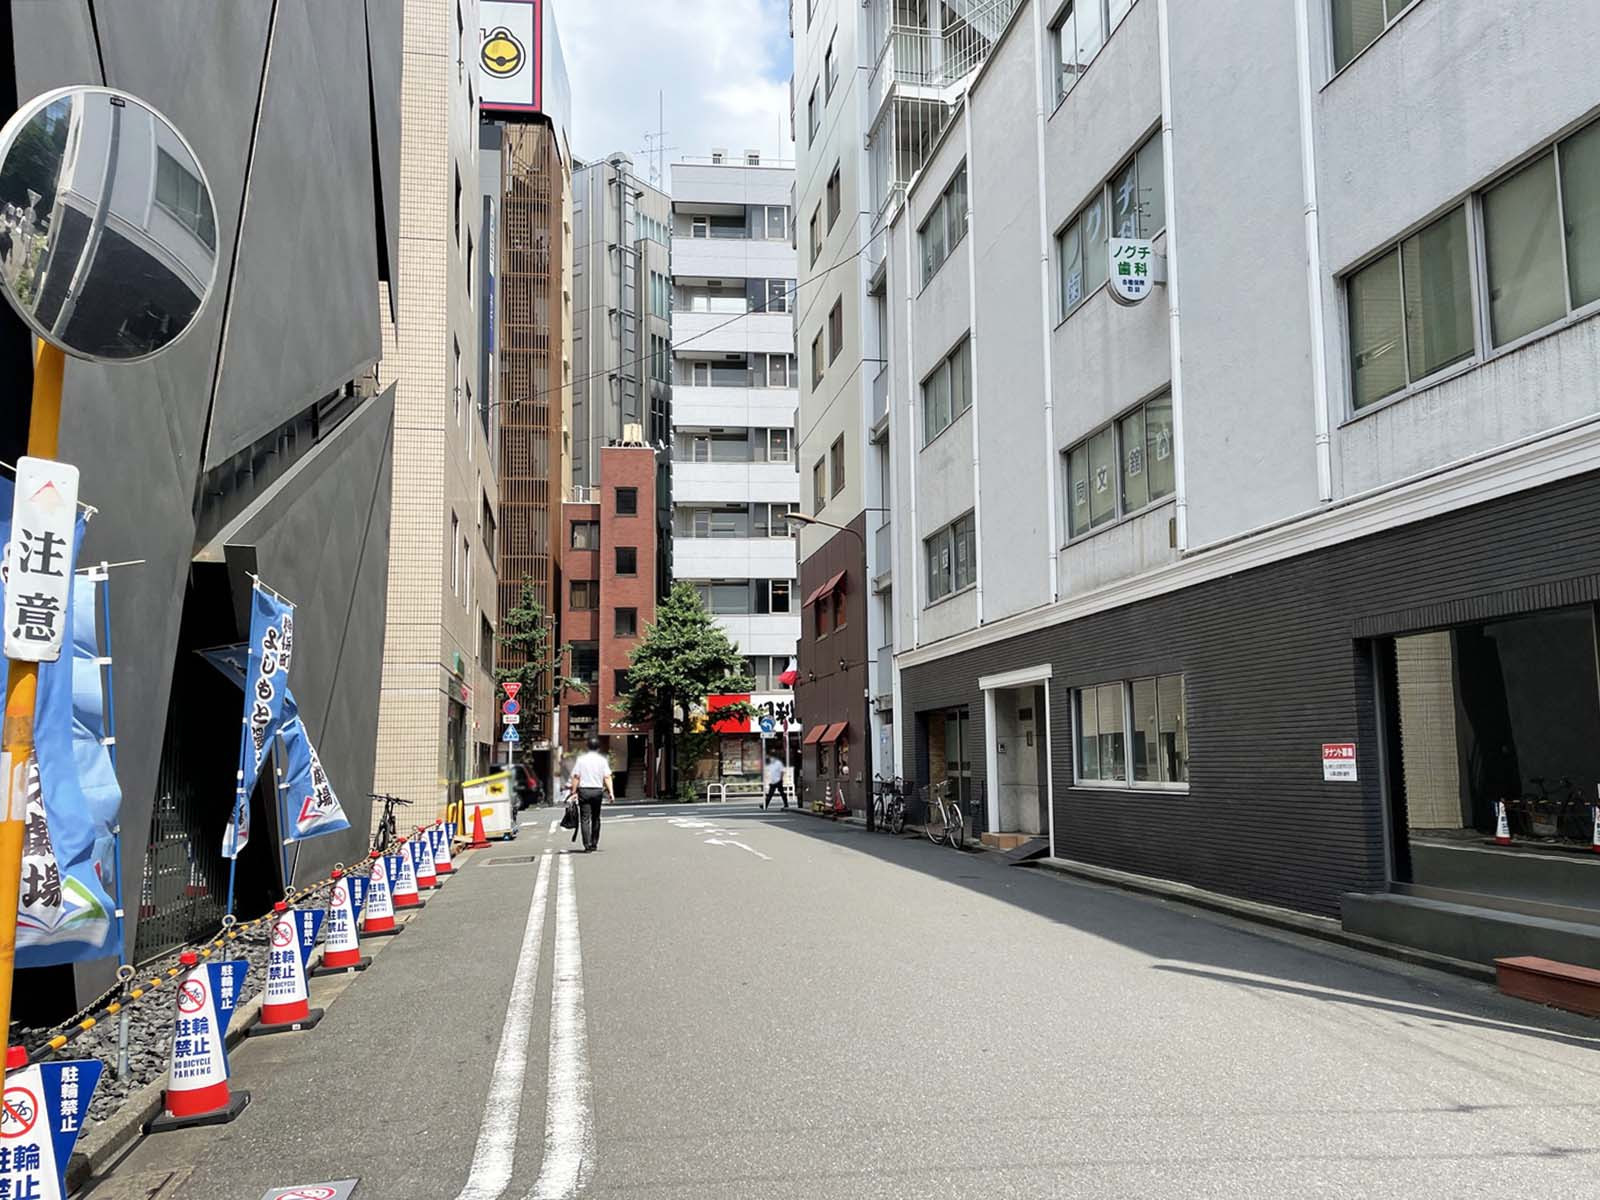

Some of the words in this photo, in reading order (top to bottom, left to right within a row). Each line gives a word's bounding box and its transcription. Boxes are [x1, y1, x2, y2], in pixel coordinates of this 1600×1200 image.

[1113, 245, 1151, 260] ノグチ
[1118, 261, 1147, 277] 歯科
[13, 528, 67, 642] 注意
[270, 950, 295, 965] 駐輪
[269, 965, 296, 980] 禁止
[175, 1017, 209, 1038] 駐輪
[175, 1037, 211, 1058] 禁止
[174, 1060, 182, 1070] NO
[183, 1057, 211, 1069] BICYCLE
[174, 1067, 212, 1079] PARKING
[60, 1066, 79, 1133] 駐輪禁止
